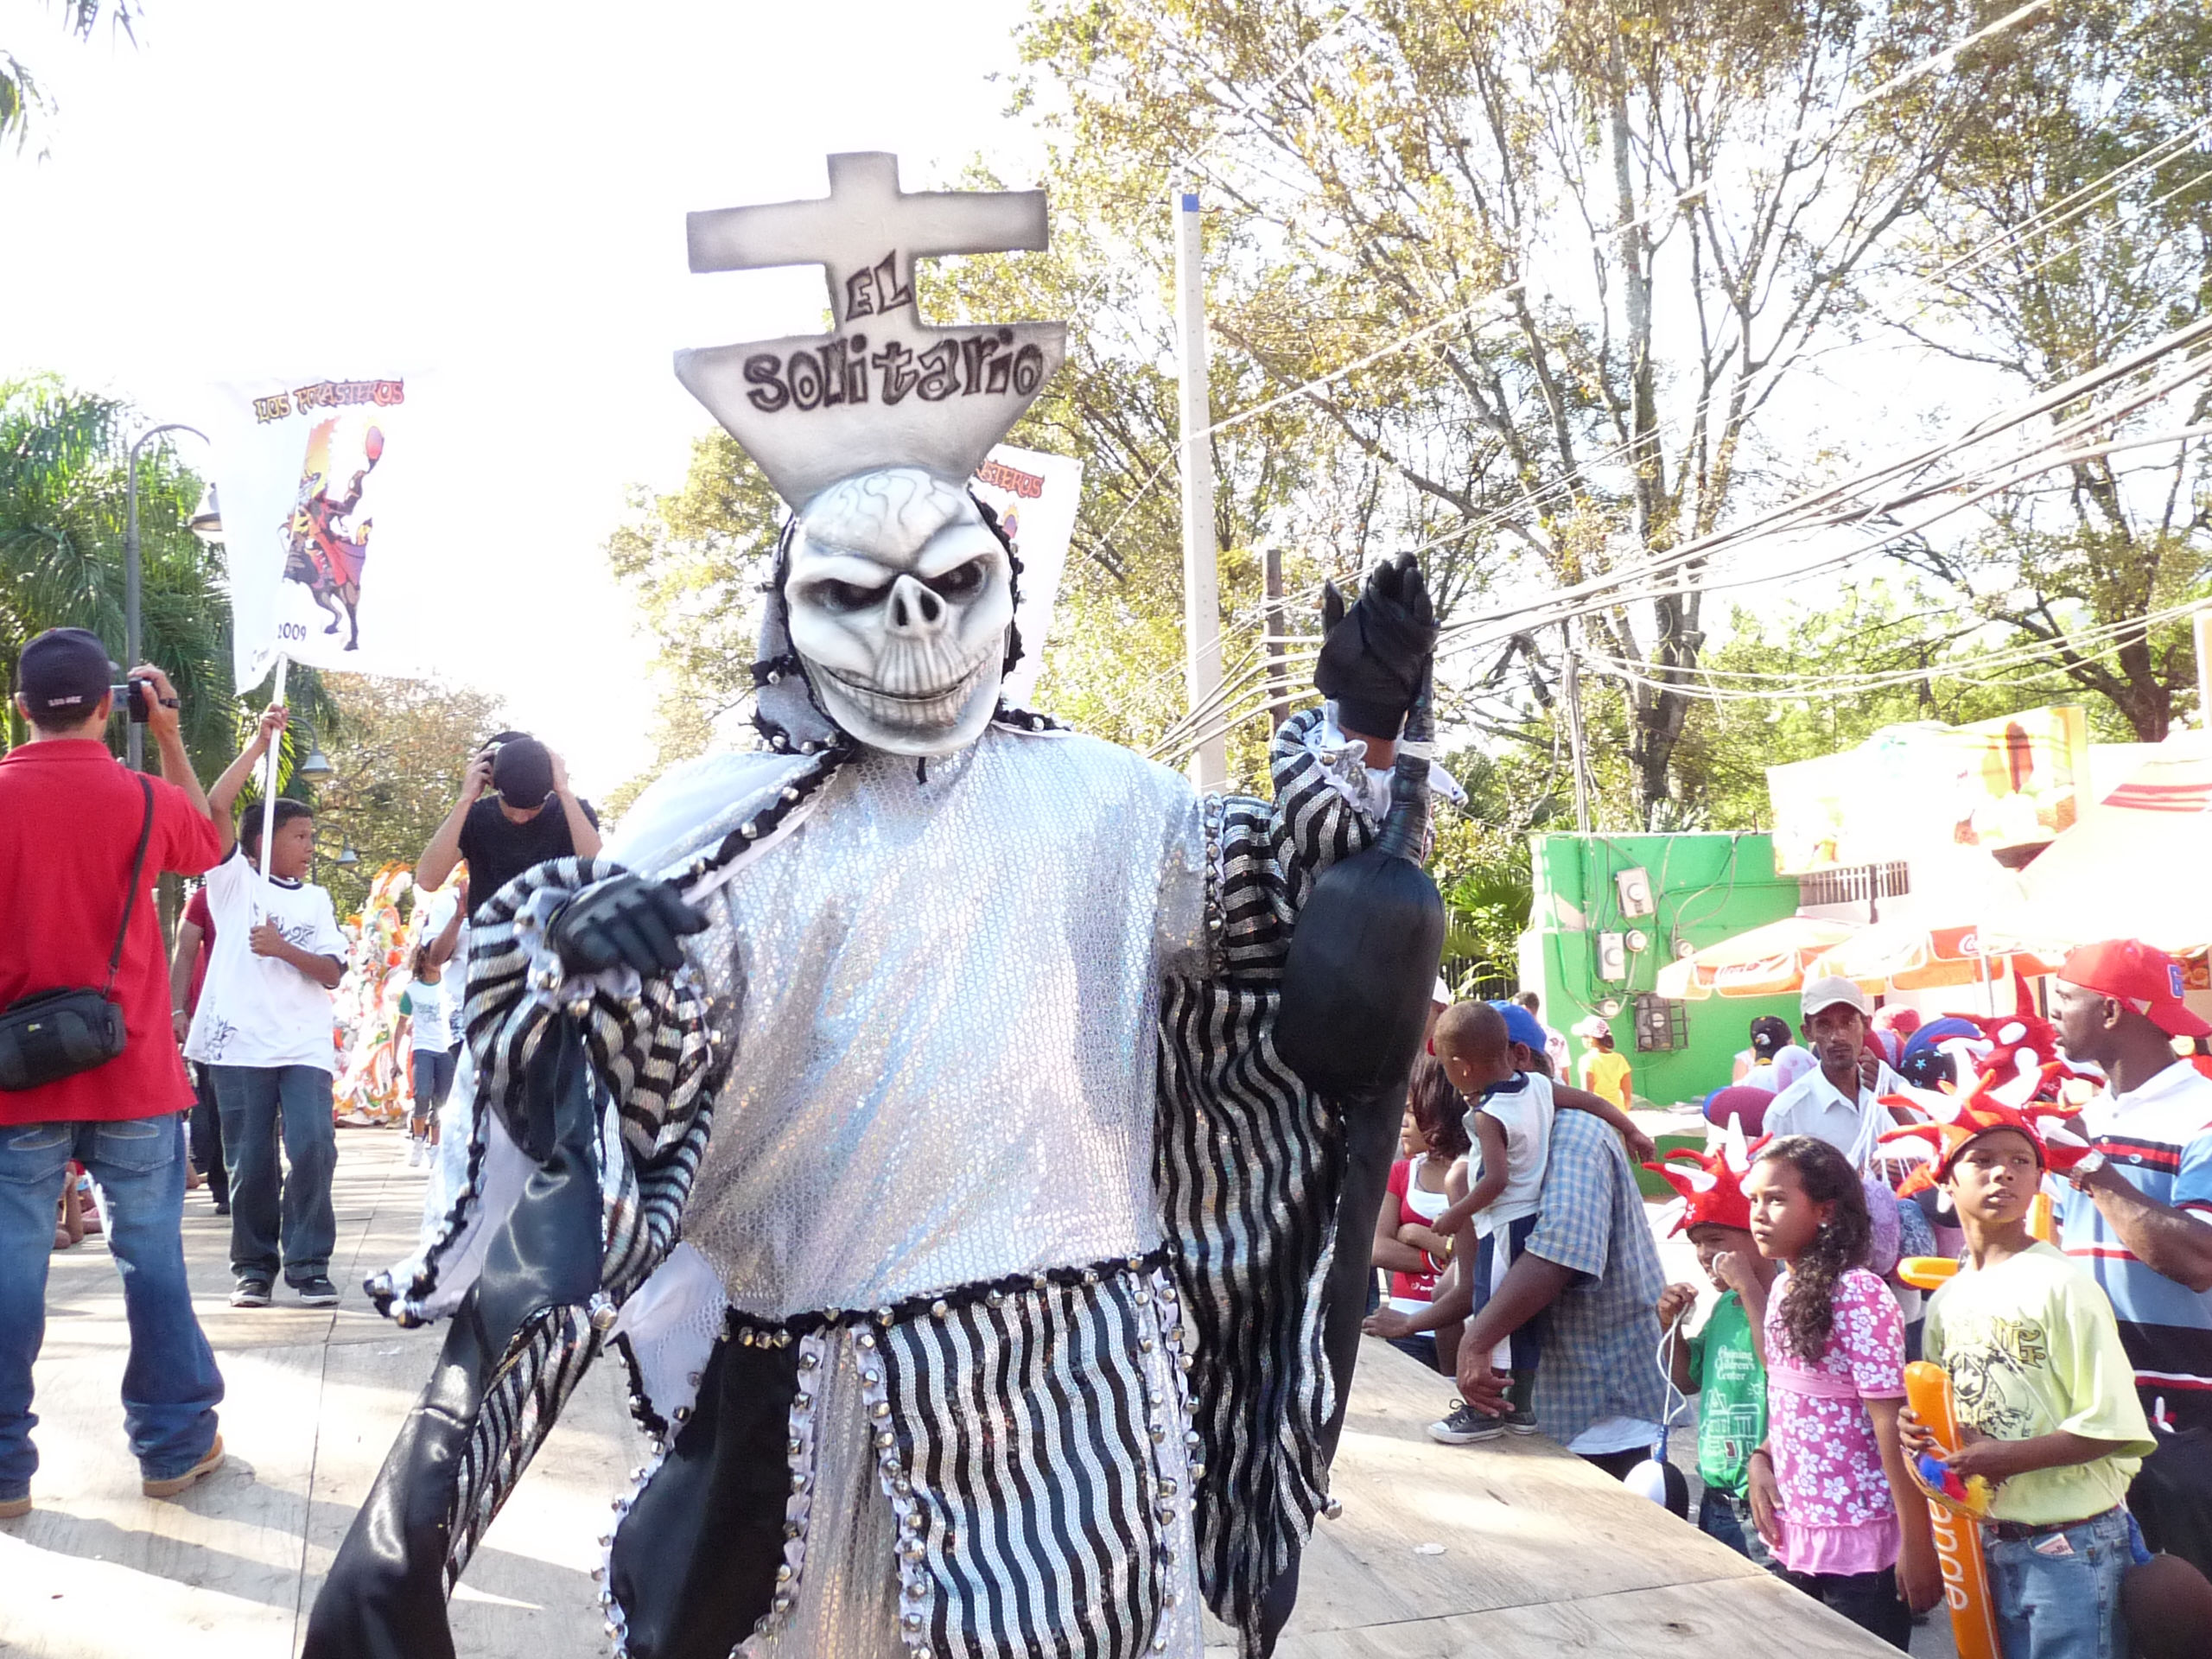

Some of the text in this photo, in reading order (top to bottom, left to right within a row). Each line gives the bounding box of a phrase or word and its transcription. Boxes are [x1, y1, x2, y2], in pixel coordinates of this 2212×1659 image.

[844, 249, 912, 323] EL
[253, 378, 404, 423] LOS FORASTEROS
[976, 459, 1045, 499] STEROS
[277, 622, 307, 641] 2009
